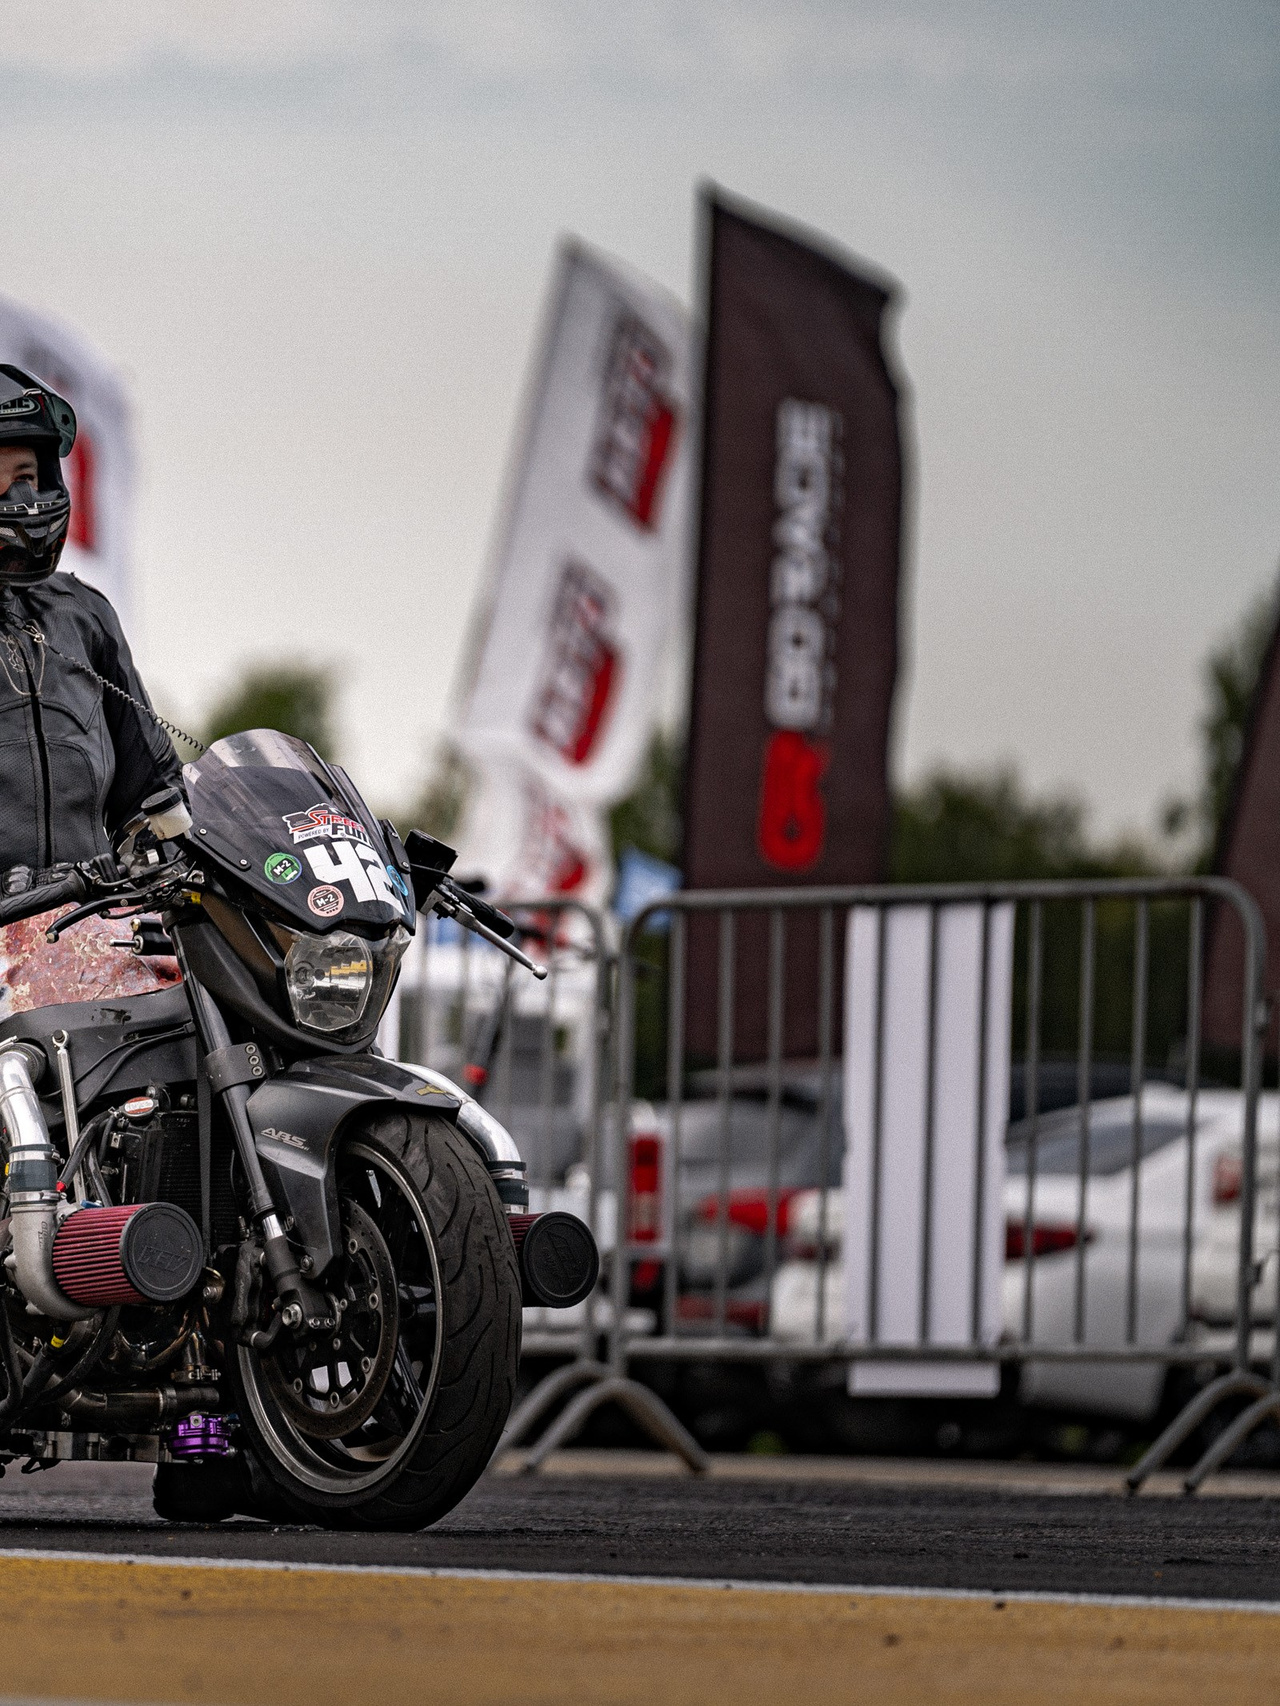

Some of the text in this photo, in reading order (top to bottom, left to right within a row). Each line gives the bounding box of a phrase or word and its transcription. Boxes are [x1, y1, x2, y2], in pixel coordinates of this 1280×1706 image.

[273, 860, 291, 876] M-2
[303, 841, 405, 915] 42
[316, 893, 335, 908] M-2
[261, 1127, 307, 1148] ABS
